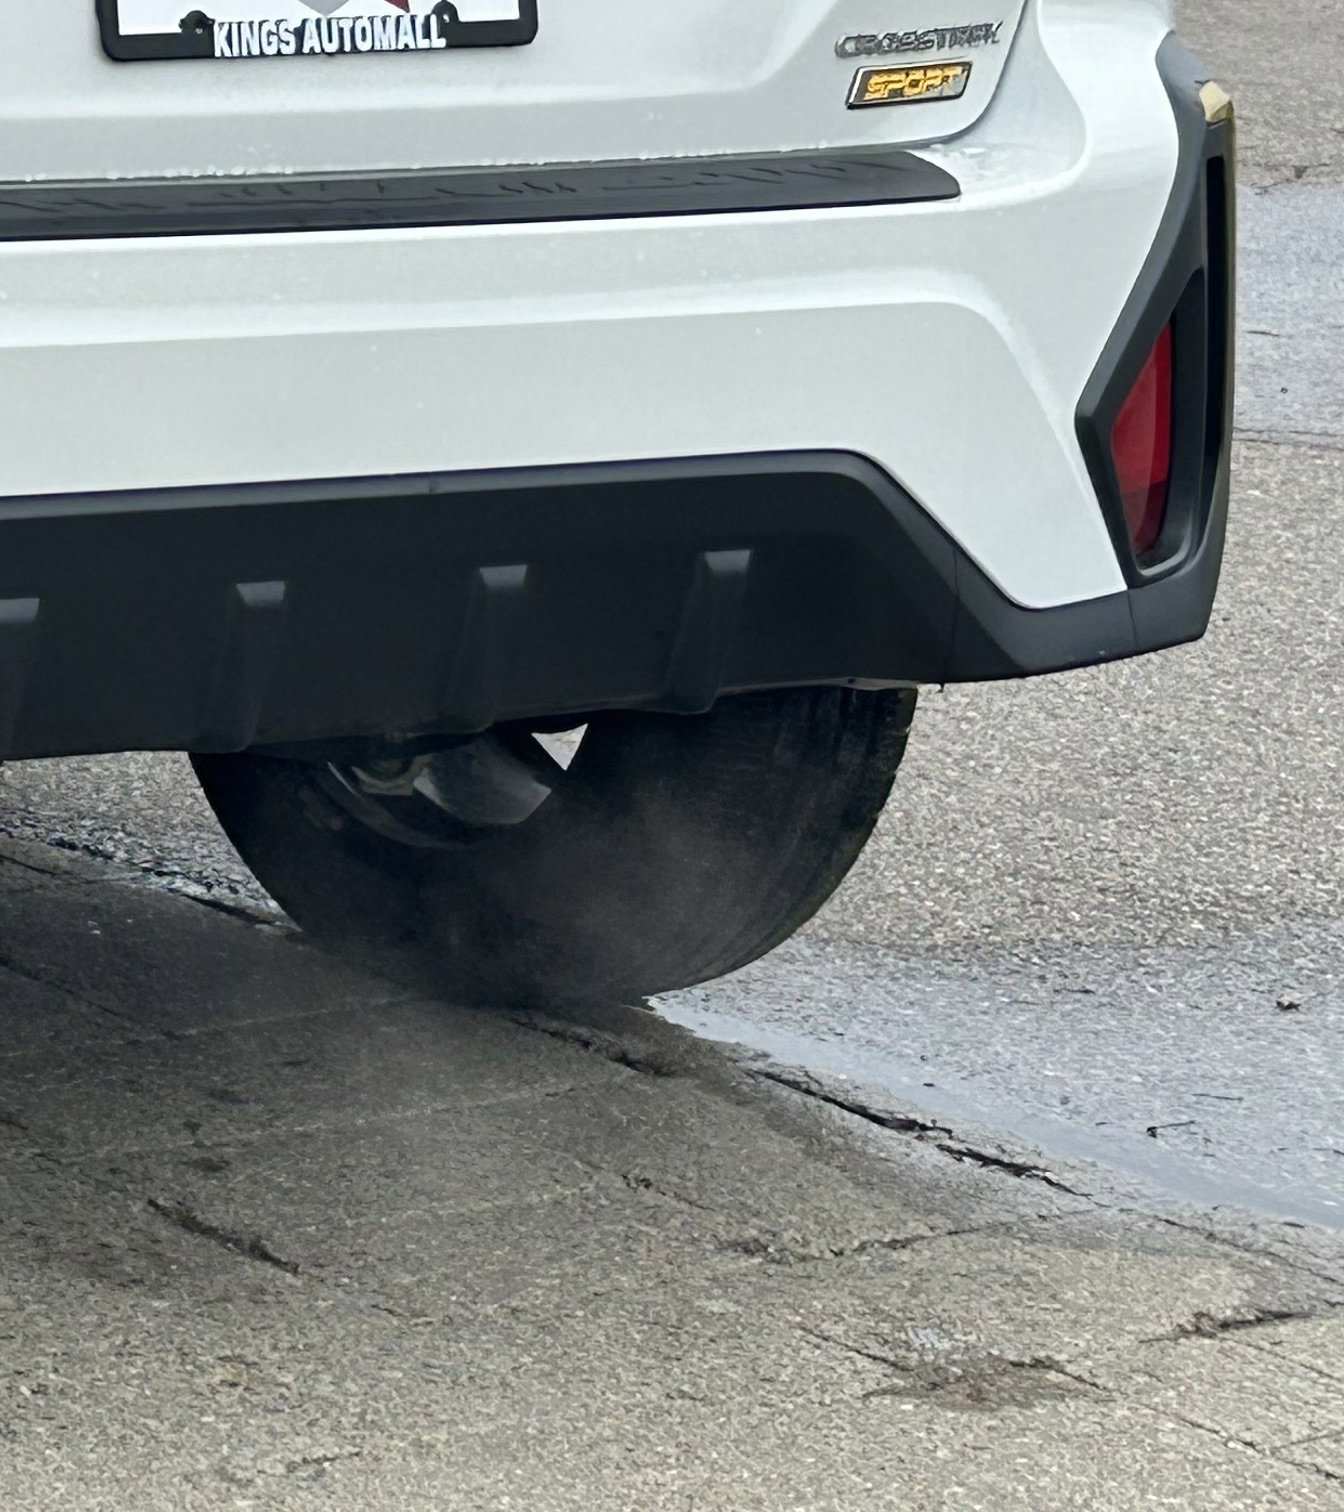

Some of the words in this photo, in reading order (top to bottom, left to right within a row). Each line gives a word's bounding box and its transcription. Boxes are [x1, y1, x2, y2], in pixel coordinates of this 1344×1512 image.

[213, 18, 295, 58] KINGS
[301, 13, 447, 55] AUTOMALL
[864, 65, 964, 102] SPORT
